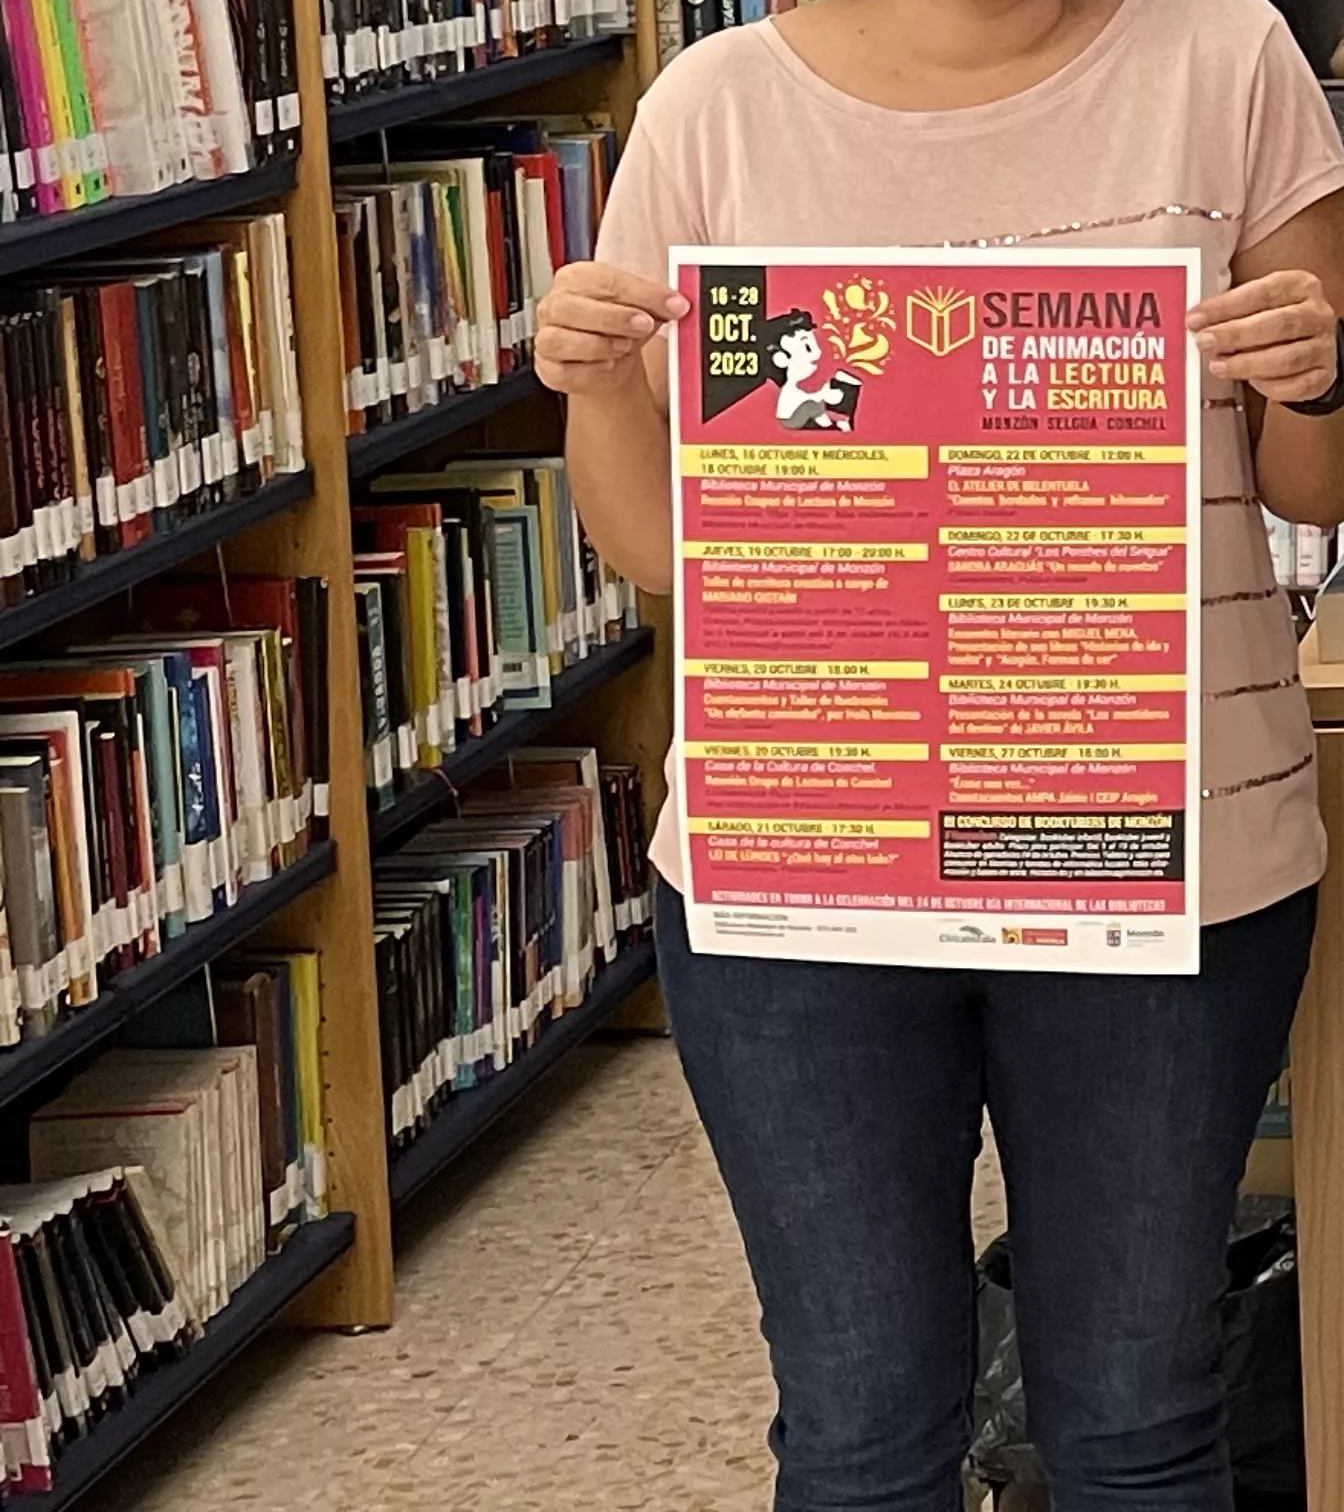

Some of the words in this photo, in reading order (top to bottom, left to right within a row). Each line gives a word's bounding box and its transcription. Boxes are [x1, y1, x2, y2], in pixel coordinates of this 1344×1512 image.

[711, 287, 727, 305] 16
[982, 291, 1162, 330] SEMANA
[710, 313, 757, 343] OCT.
[982, 335, 1015, 361] DE
[1022, 330, 1165, 361] ANIMACIÓN
[710, 352, 760, 376] 2023
[982, 362, 998, 385] A
[1008, 362, 1040, 385] LA
[1050, 362, 1166, 386] LECTURA
[982, 388, 998, 411] Y
[1008, 388, 1037, 411] LA
[1047, 388, 1168, 411] ESCRITURA
[982, 415, 1039, 431] MONZÓN
[1047, 416, 1099, 431] SELGUA
[1107, 416, 1167, 431] CONCHEL
[1015, 679, 1066, 690] OCTUBRE
